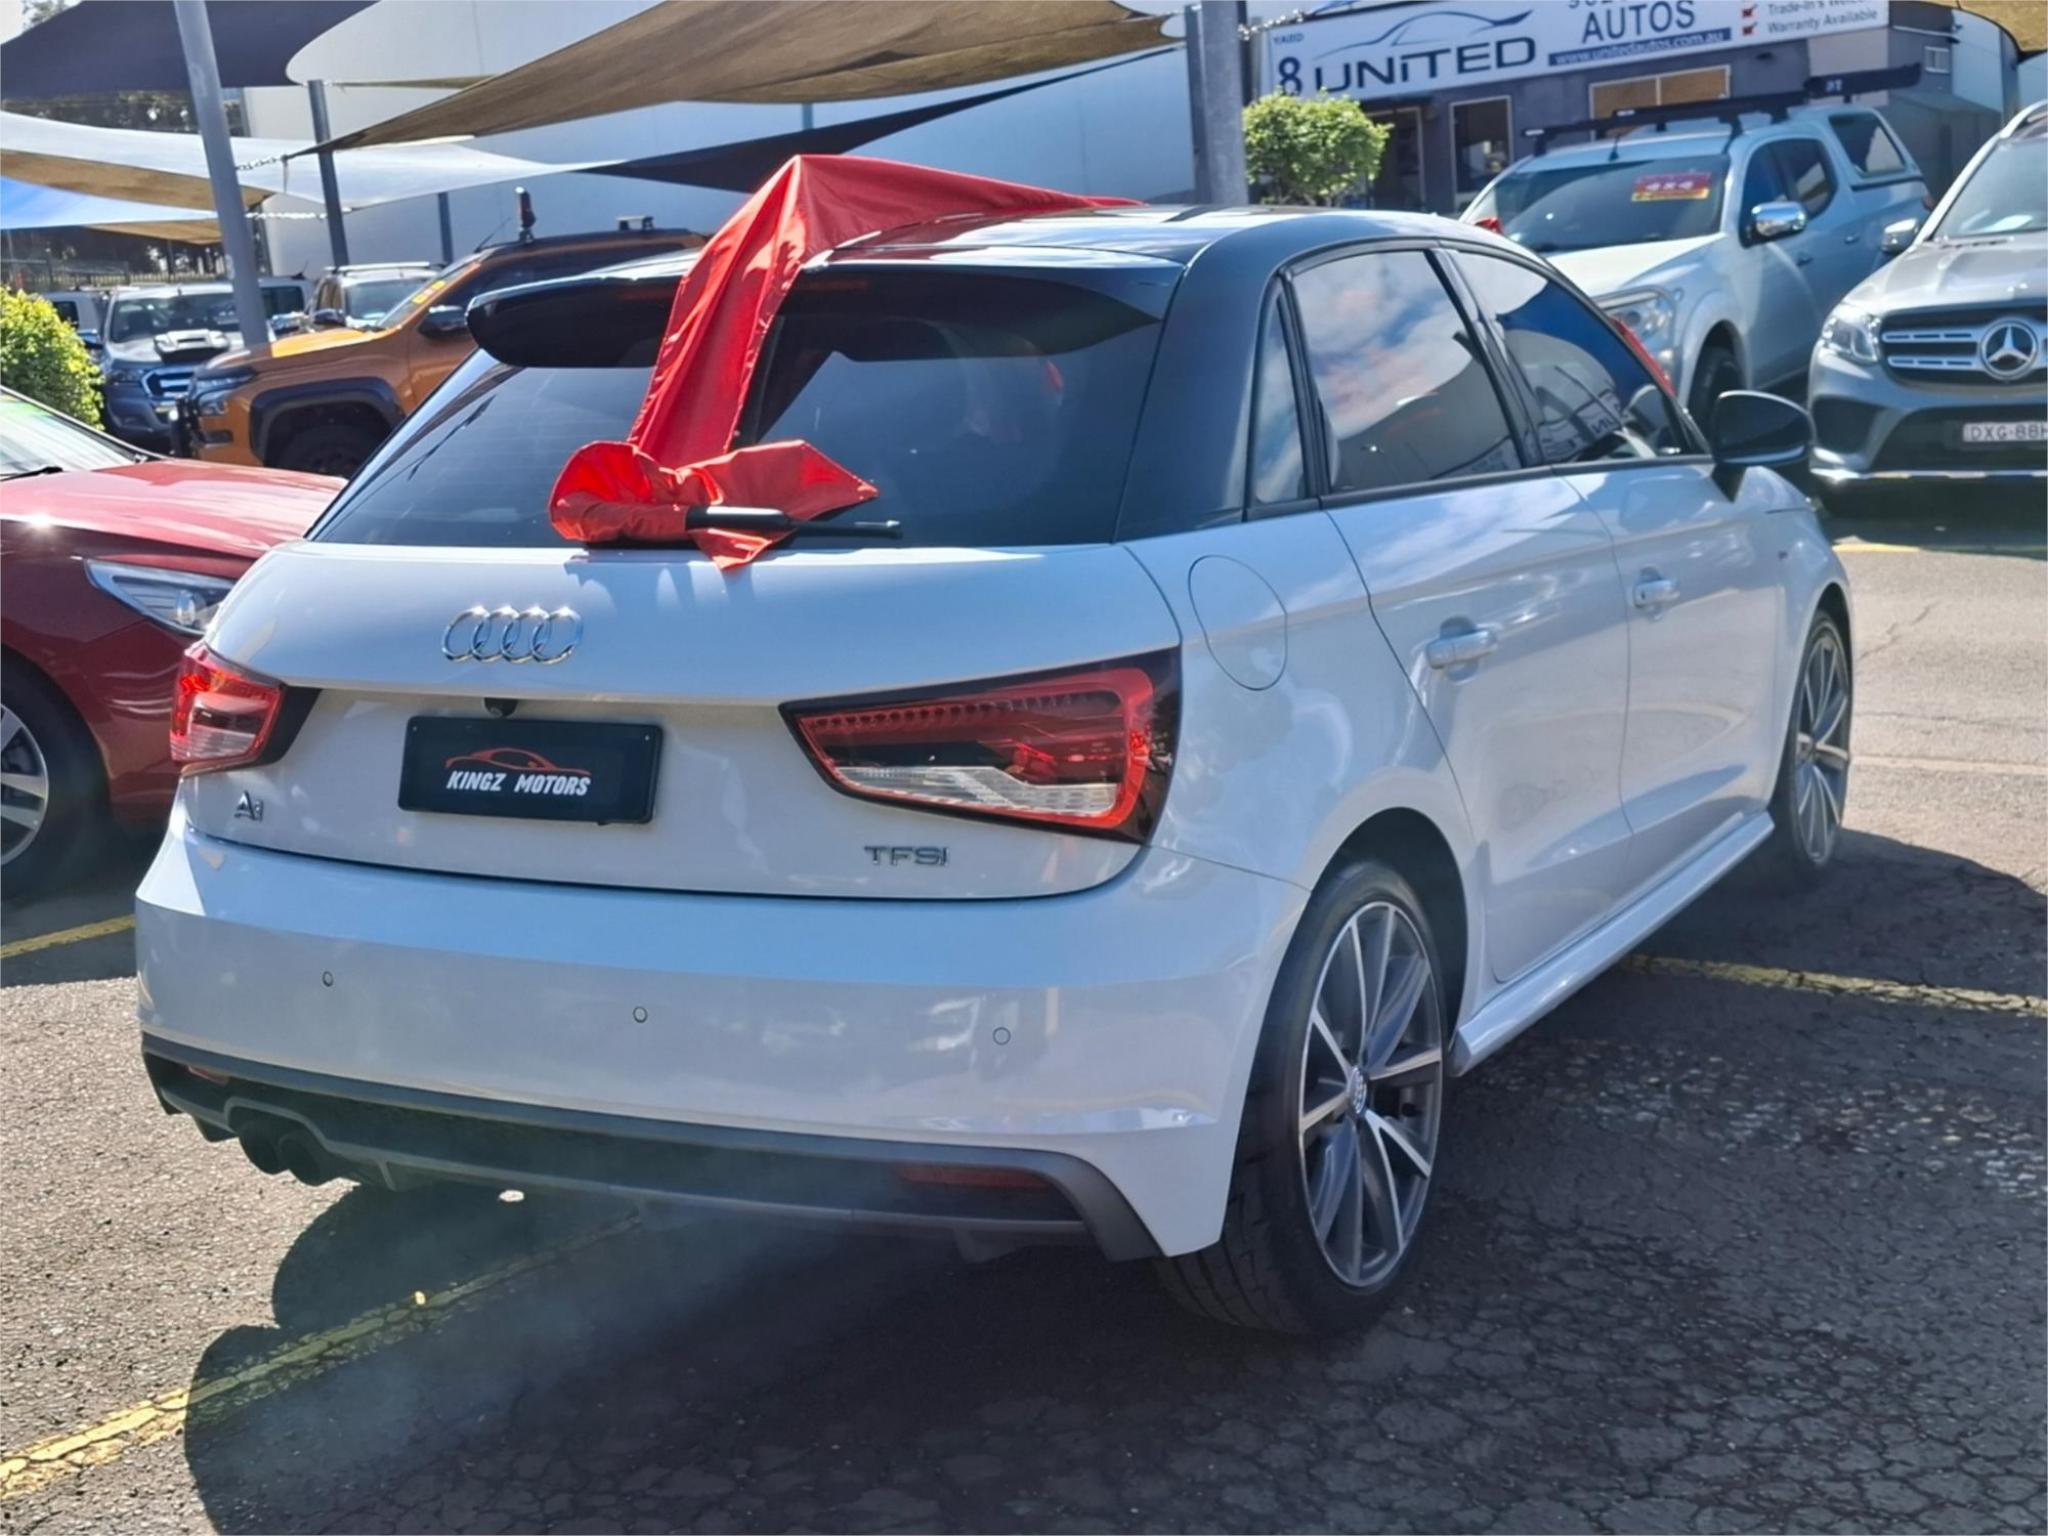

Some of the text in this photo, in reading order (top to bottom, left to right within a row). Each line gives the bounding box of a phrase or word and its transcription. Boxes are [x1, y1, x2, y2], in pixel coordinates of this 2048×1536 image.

[1581, 0, 1696, 44] AUTOS
[1768, 8, 1877, 33] Warranty Available
[1278, 56, 1303, 97] 8
[1314, 36, 1536, 93] UNITED
[446, 770, 592, 797] KINGZ MOTORS
[863, 846, 948, 866] TFSI
